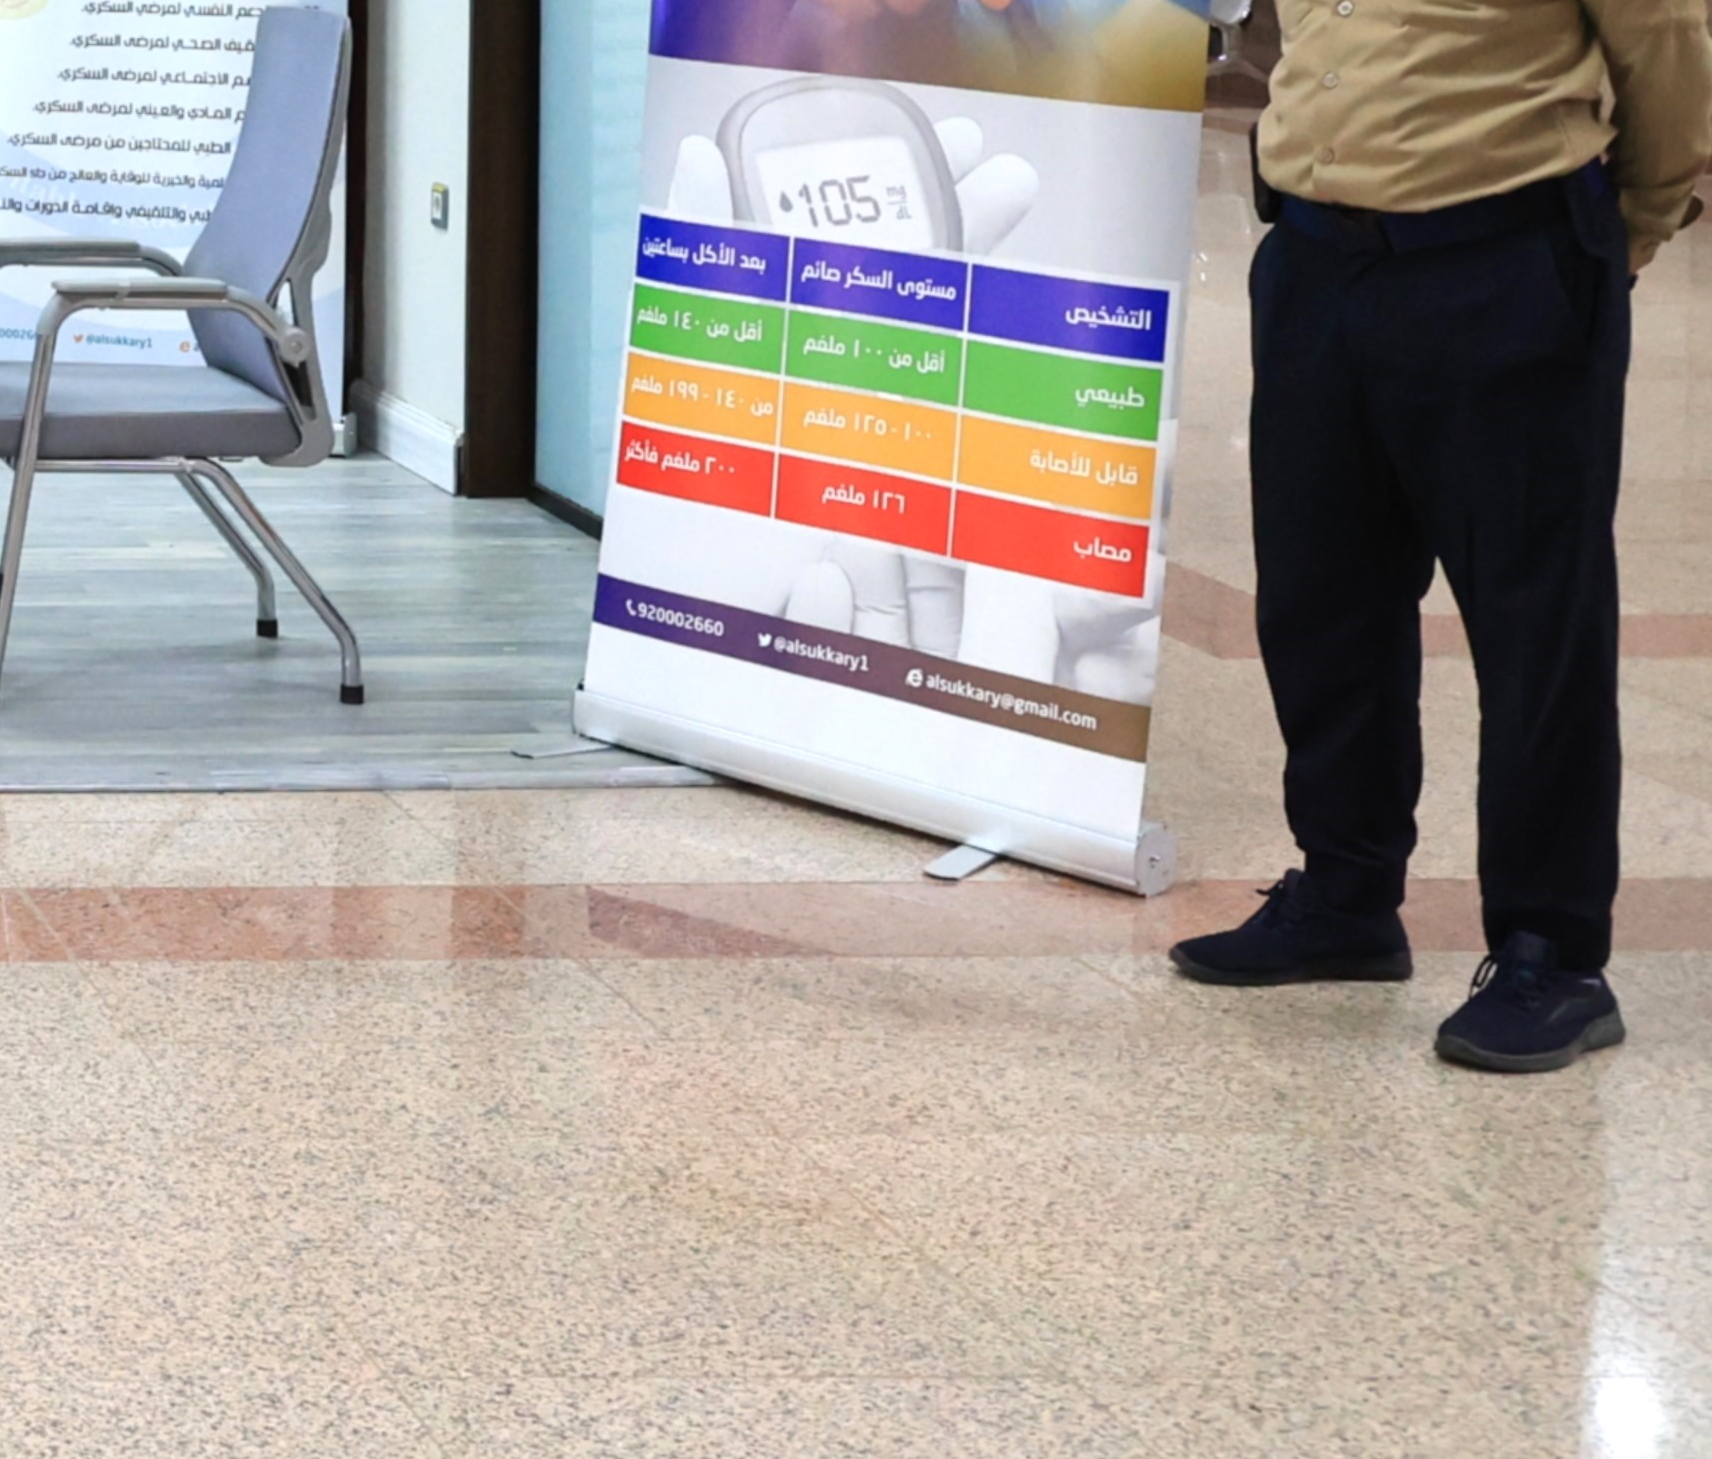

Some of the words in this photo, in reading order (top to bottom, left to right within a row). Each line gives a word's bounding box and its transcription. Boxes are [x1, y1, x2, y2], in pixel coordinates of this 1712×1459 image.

[798, 175, 881, 228] 105
[641, 236, 689, 263] بساعتين
[691, 242, 736, 266] الأكل
[738, 254, 766, 275] بعد
[800, 260, 841, 283] صائم
[843, 265, 893, 290] السكر
[895, 278, 957, 301] مستوى
[673, 309, 700, 330] ١٤٠
[705, 318, 730, 338] من
[732, 318, 763, 343] أقل
[1064, 305, 1152, 331] التشخيص
[802, 334, 846, 356] ملغم
[887, 348, 913, 369] من
[915, 349, 945, 374] أقل
[749, 397, 774, 417] من
[1074, 385, 1145, 410] طبيعي
[802, 406, 846, 429] ملغم
[623, 438, 659, 464] فأكثر
[1029, 448, 1091, 478] للأصابة
[704, 455, 735, 475] ٢٠٠
[1094, 460, 1138, 487] قابل
[821, 483, 866, 506] ملغم
[872, 489, 905, 514] ١٢٦
[1072, 536, 1132, 563] مصاب
[637, 602, 725, 637] 920002660
[773, 635, 870, 672] @alsukkary1
[926, 673, 1098, 731] alsukkary@gmail.com
